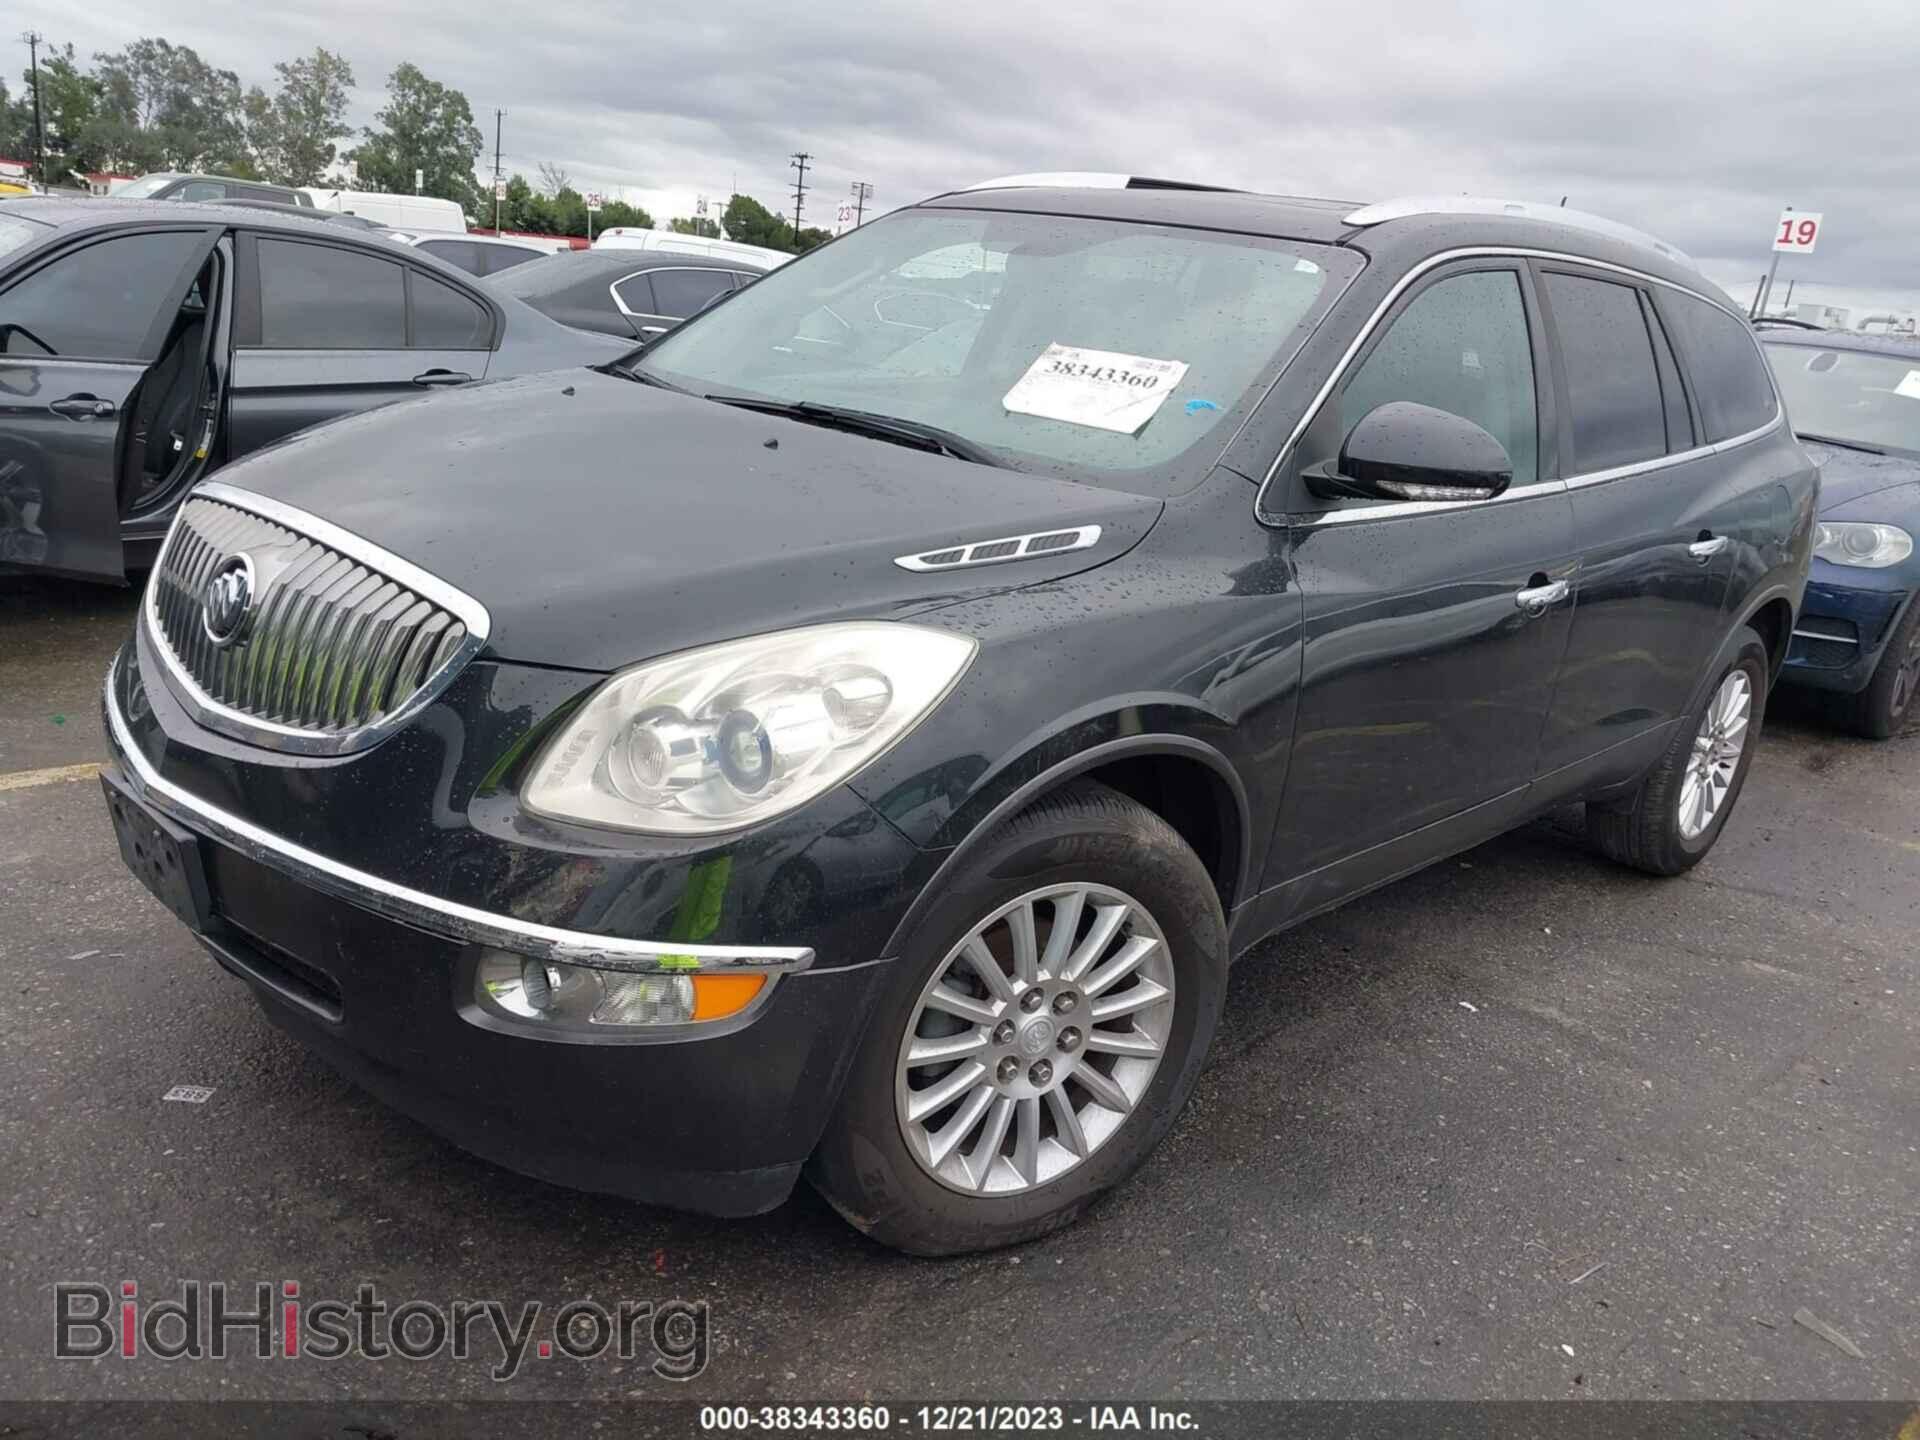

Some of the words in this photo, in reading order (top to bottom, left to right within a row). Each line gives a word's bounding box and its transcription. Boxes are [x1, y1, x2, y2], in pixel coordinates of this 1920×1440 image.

[587, 193, 600, 207] 25
[838, 206, 850, 221] 23
[1777, 220, 1816, 245] 19
[1045, 361, 1158, 388] 38343360
